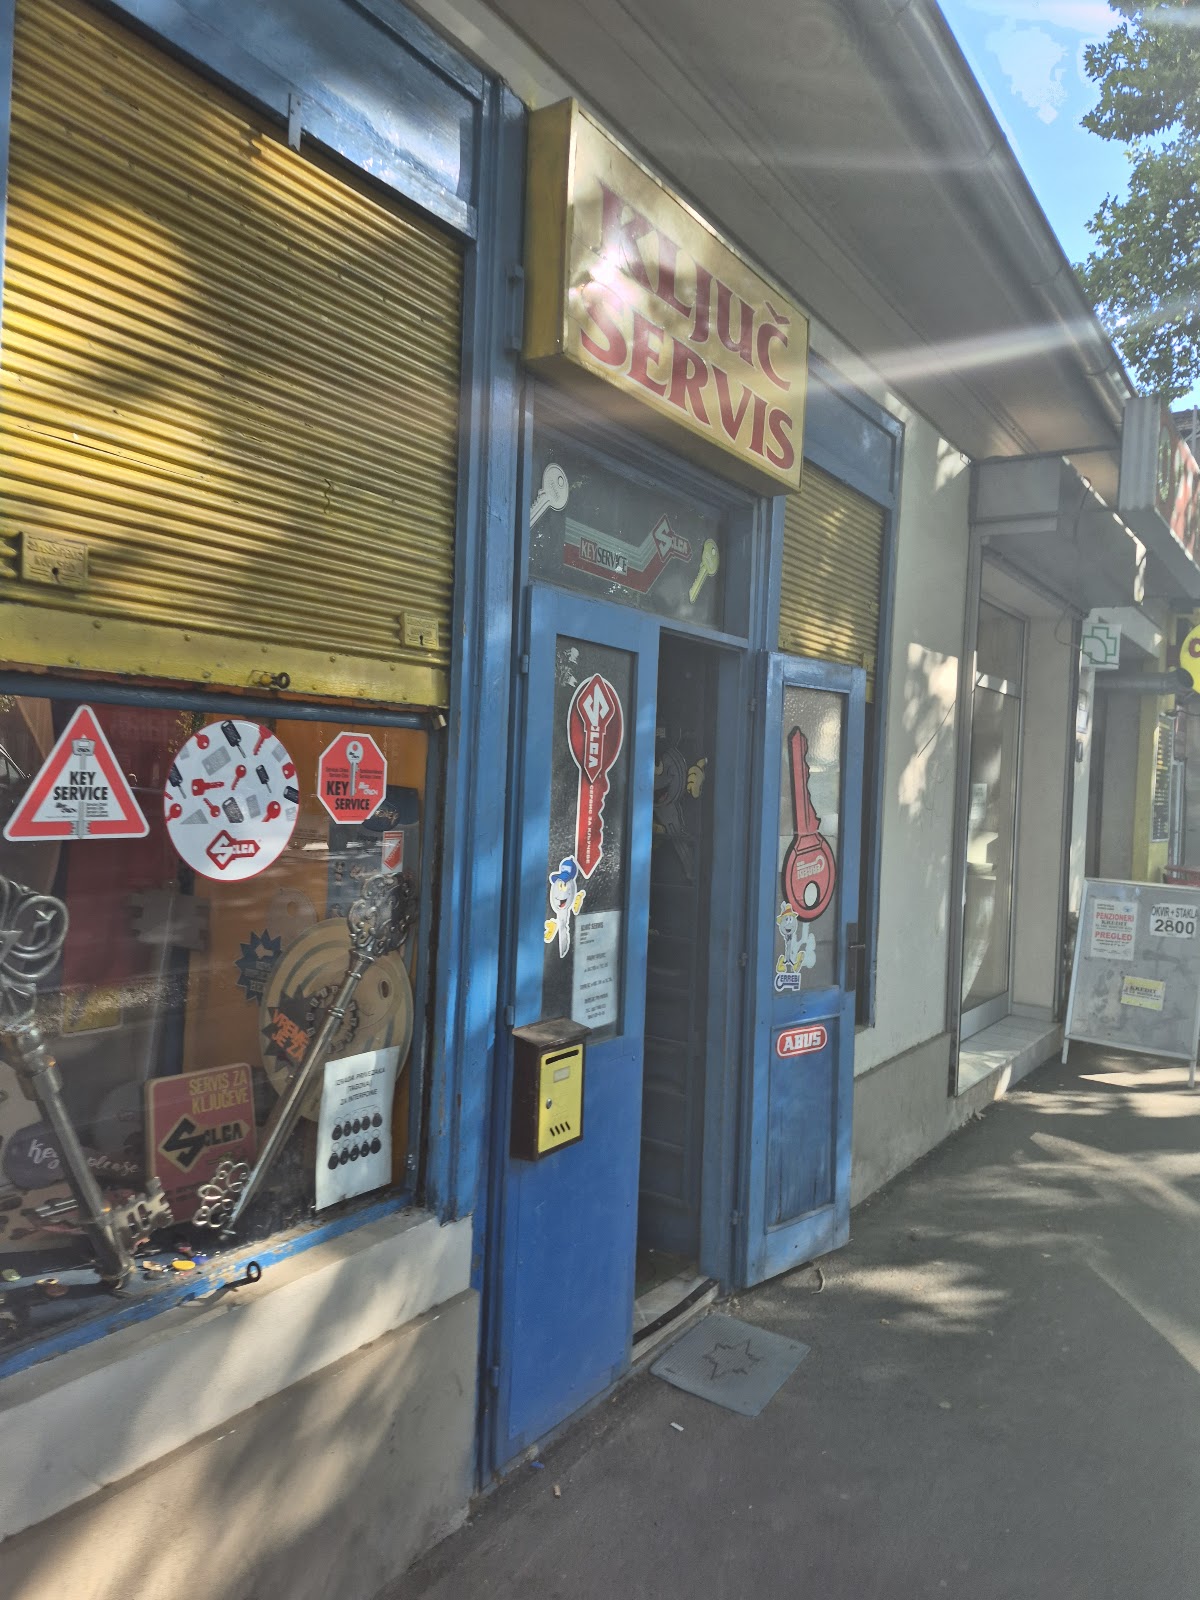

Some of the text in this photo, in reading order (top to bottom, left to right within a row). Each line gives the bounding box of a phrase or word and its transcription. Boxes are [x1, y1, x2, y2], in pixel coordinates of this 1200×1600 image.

[599, 180, 790, 391] KLJUČ
[580, 287, 794, 470] SERVIS
[582, 683, 610, 768] SILCA
[70, 771, 96, 785] KEY
[53, 787, 108, 800] SERVICE
[326, 780, 349, 796] KEY
[335, 798, 370, 810] SERVICE
[1096, 912, 1134, 922] PENZIONERI
[1151, 906, 1169, 917] OKVIR
[1154, 919, 1195, 935] 2800
[1094, 931, 1132, 941] PREGLED
[783, 1031, 822, 1051] ABUS
[190, 1069, 248, 1096] SERVIS ZA
[192, 1087, 249, 1114] KLJUČEVE
